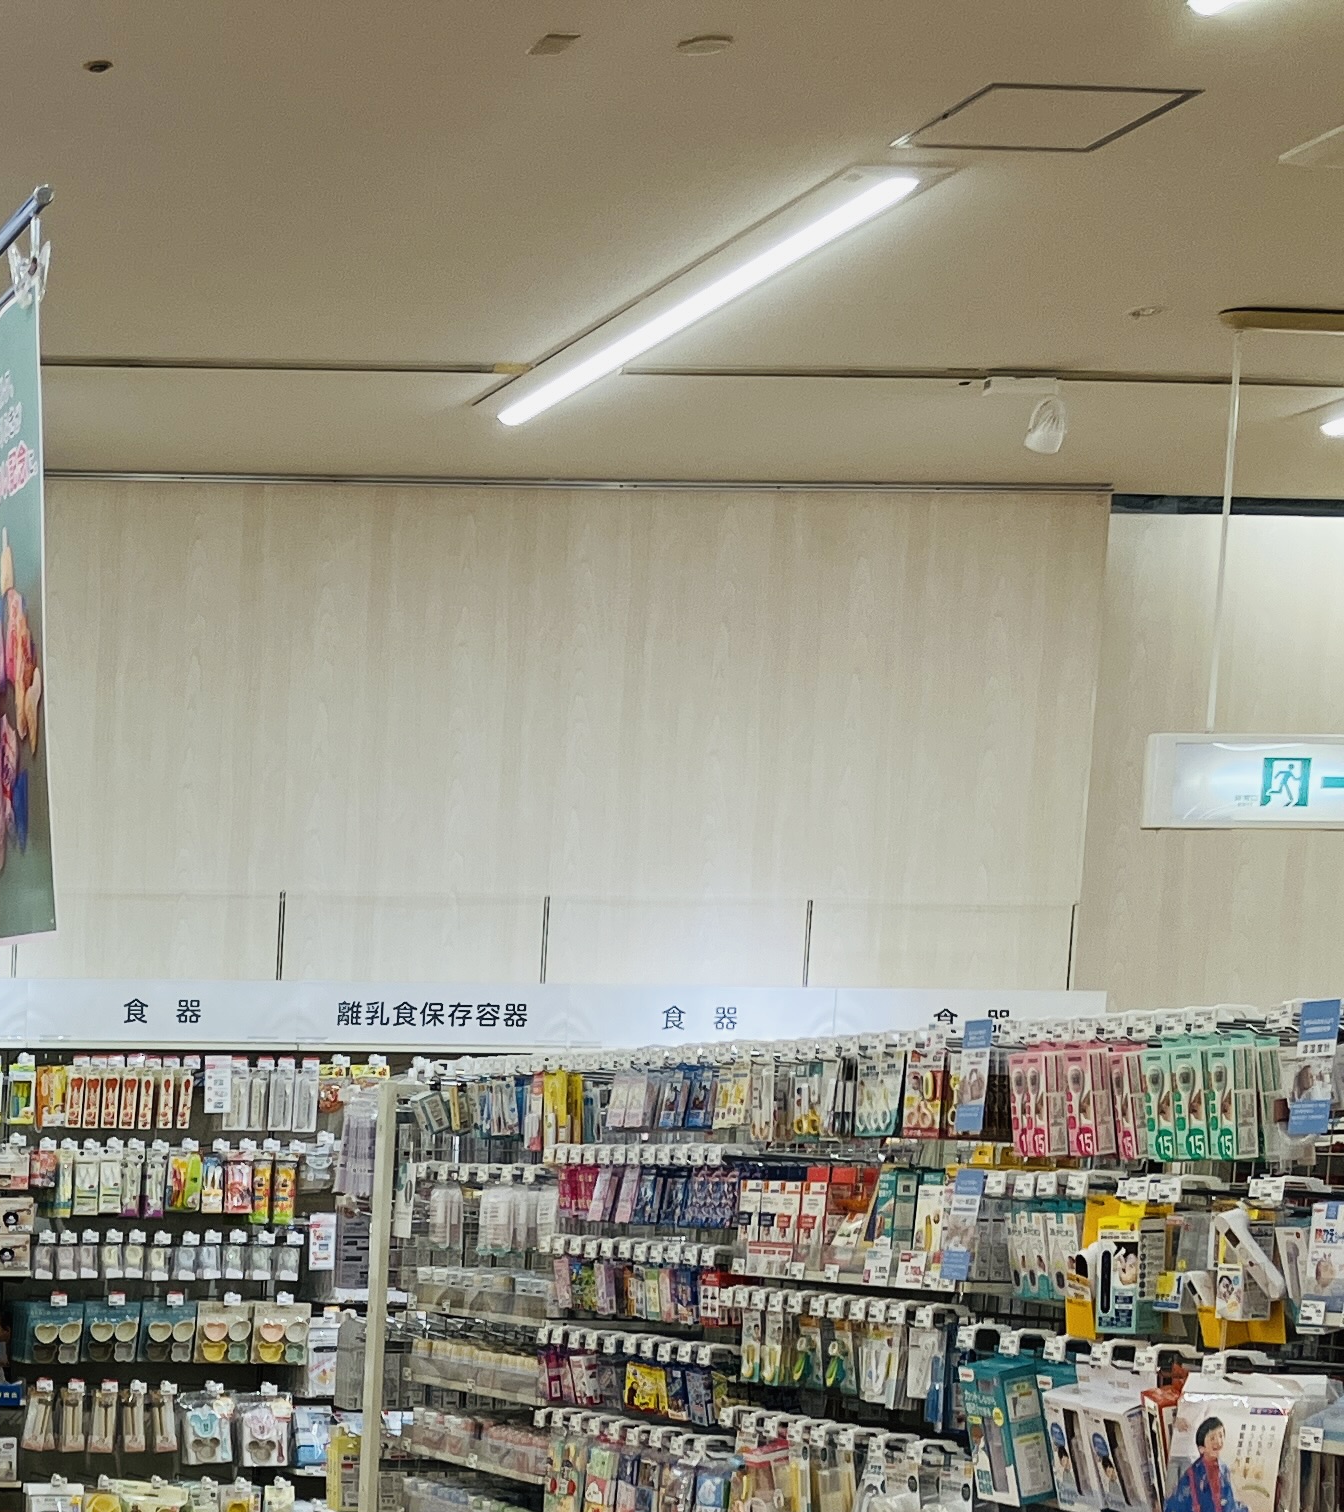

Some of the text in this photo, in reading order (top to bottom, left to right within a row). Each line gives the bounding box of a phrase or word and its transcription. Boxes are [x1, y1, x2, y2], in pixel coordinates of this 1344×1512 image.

[336, 1000, 528, 1028] 離乳食保存容器
[1033, 1133, 1045, 1151] 15
[1080, 1133, 1093, 1151] 15
[1159, 1135, 1173, 1154] 15
[1191, 1135, 1205, 1154] 15
[1222, 1135, 1234, 1154] 15
